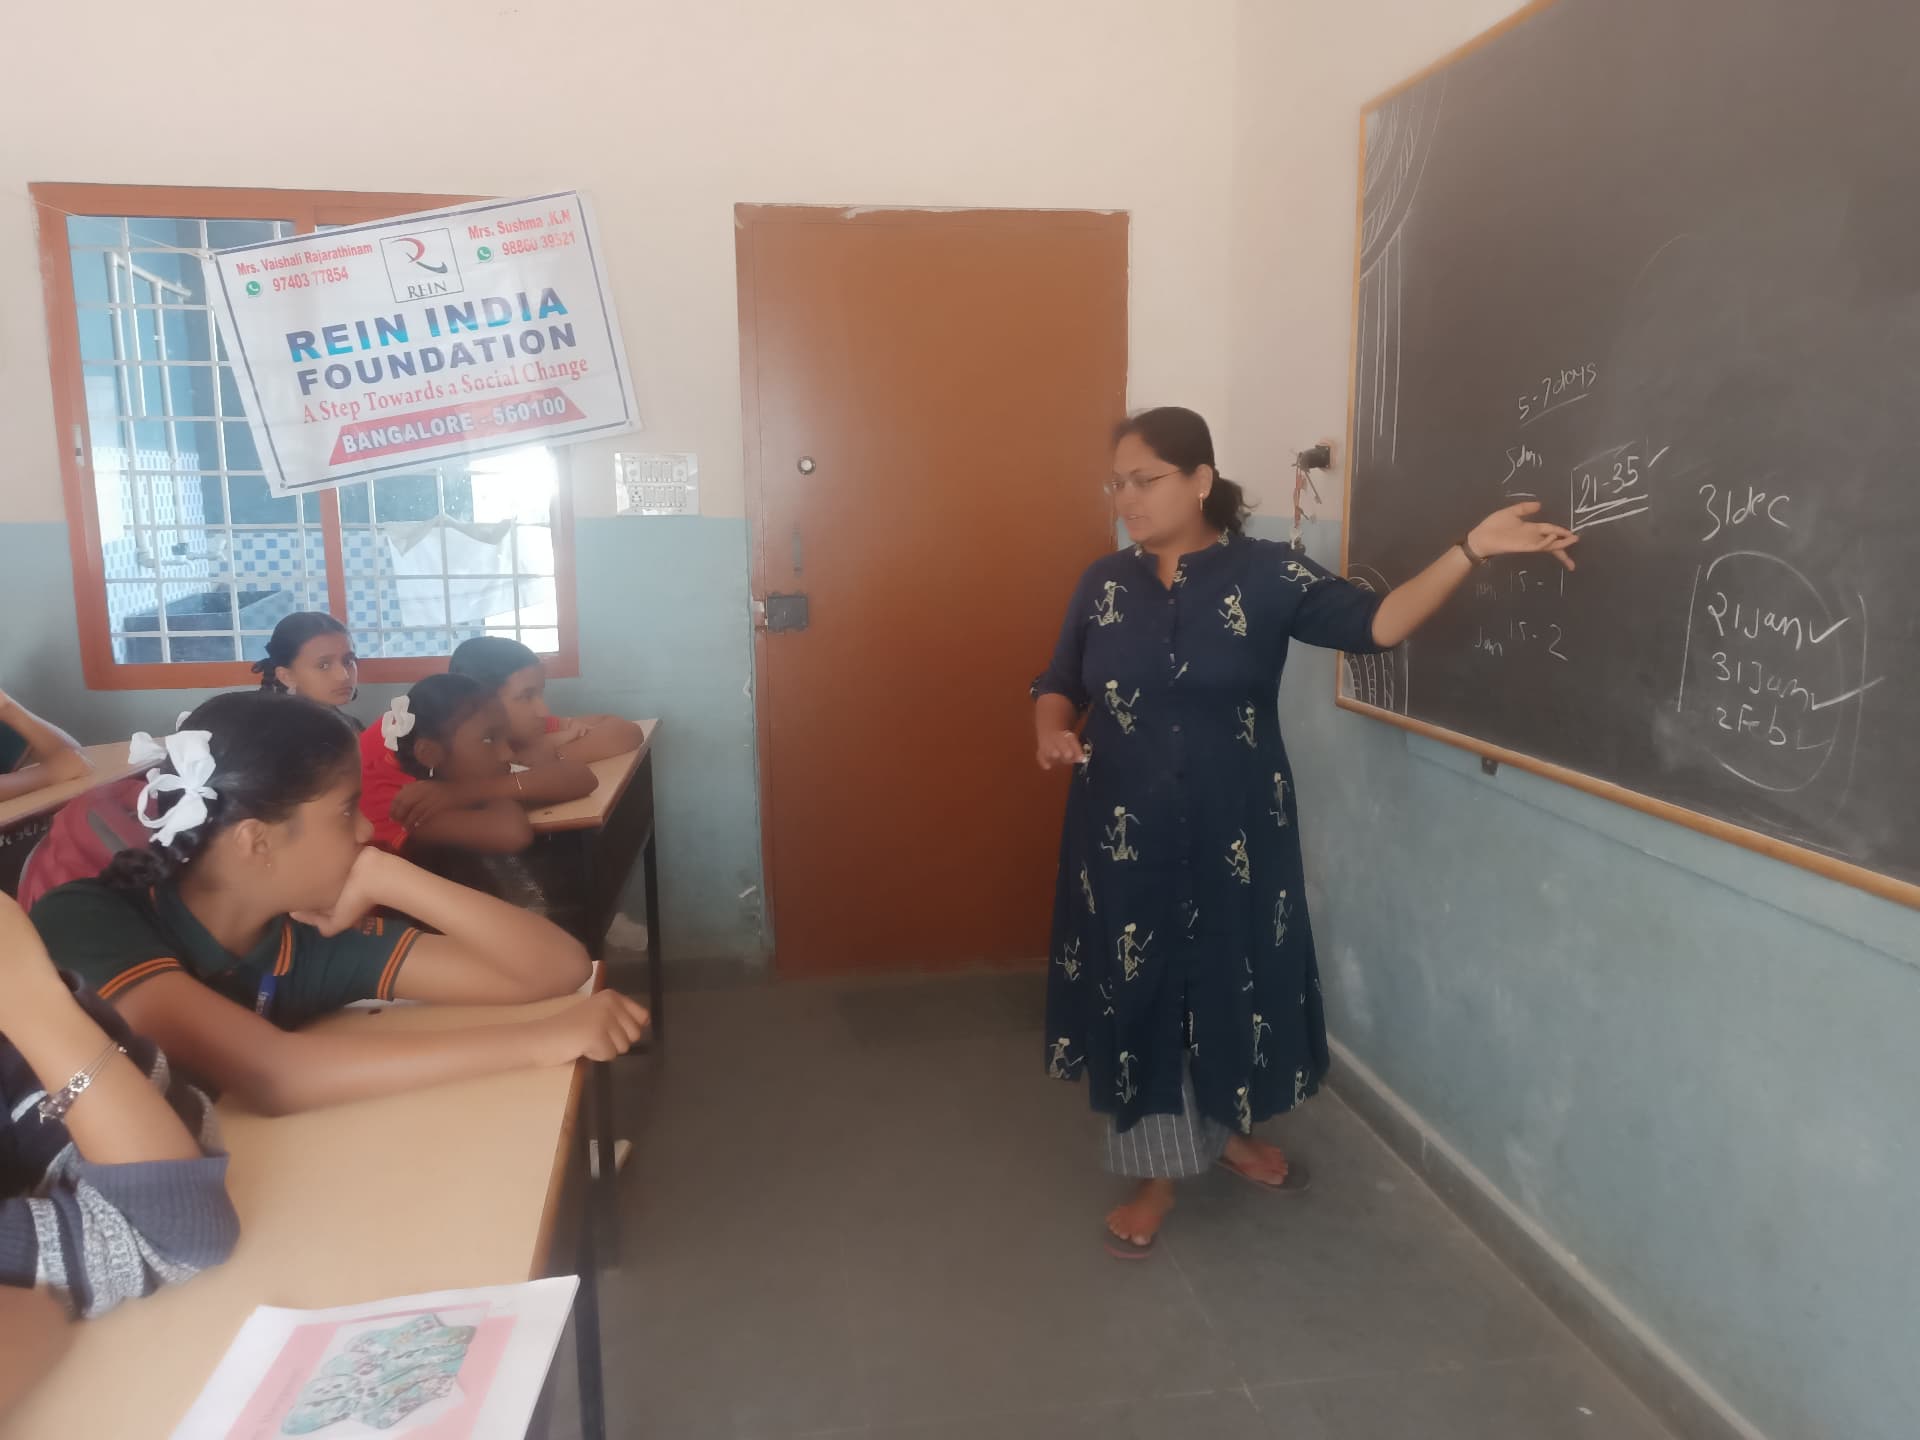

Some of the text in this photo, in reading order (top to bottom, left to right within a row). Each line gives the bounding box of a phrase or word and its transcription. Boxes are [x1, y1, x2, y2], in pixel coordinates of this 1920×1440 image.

[468, 225, 495, 241] Mrs.
[497, 215, 543, 234] Sushma
[236, 244, 373, 276] Mrs. Vaishali Rajarathinam
[273, 273, 310, 292] 97403
[407, 281, 448, 299] REIN
[285, 287, 568, 362] REIN INDIA
[297, 322, 577, 396] FOUNDATION
[303, 358, 589, 424] A Step Towards a Social Change
[341, 412, 475, 454] BANGALORE
[492, 396, 567, 426] 560100
